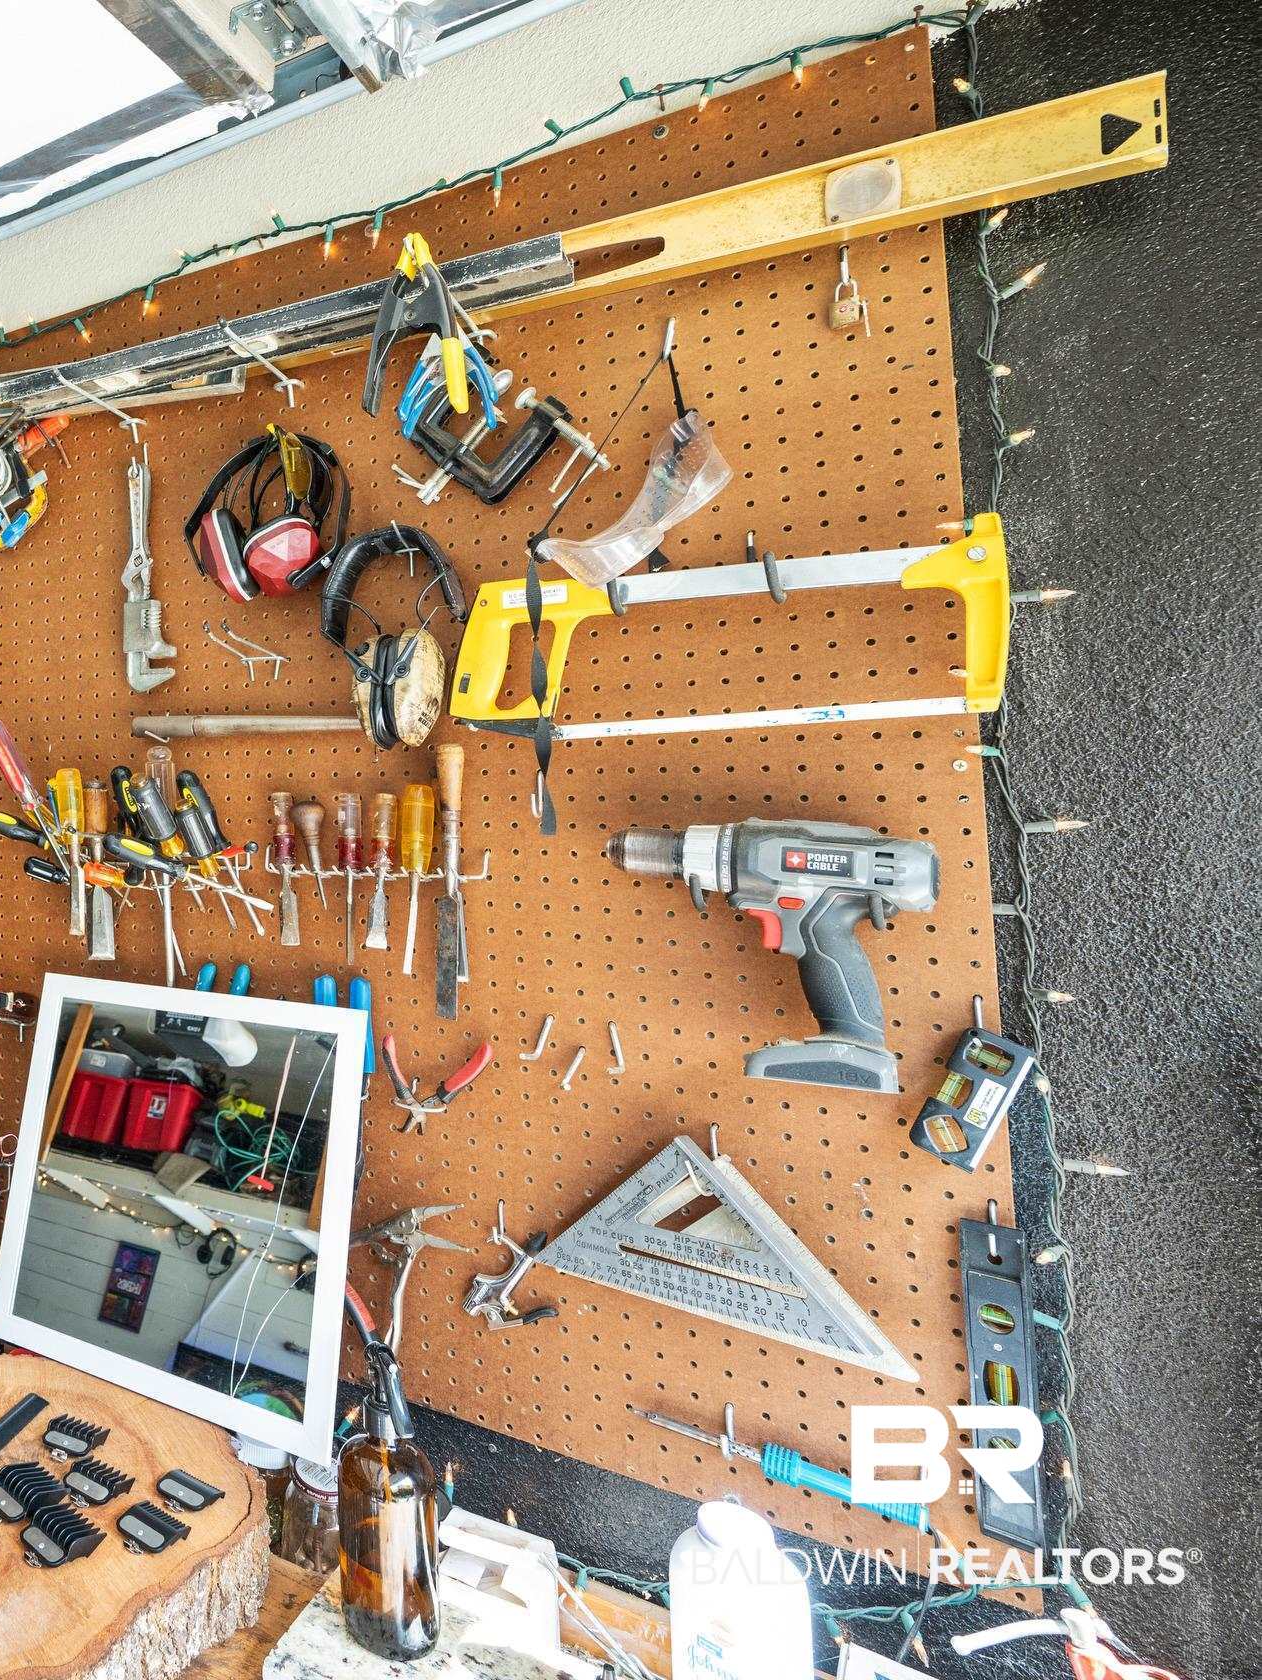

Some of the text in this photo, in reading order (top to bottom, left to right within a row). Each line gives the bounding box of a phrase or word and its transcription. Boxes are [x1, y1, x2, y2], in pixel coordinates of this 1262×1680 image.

[806, 852, 848, 864] PORTER
[806, 862, 839, 872] CABLE
[656, 1168, 679, 1188] PIVOT
[590, 1226, 635, 1244] TOP CUTS
[662, 1280, 675, 1291] 50
[676, 1284, 689, 1295] 45
[720, 1296, 733, 1307] 30
[737, 1300, 749, 1311] 25
[754, 1306, 767, 1316] 20
[775, 1311, 785, 1322] 15
[797, 1317, 808, 1328] 10
[824, 1324, 832, 1334] 5
